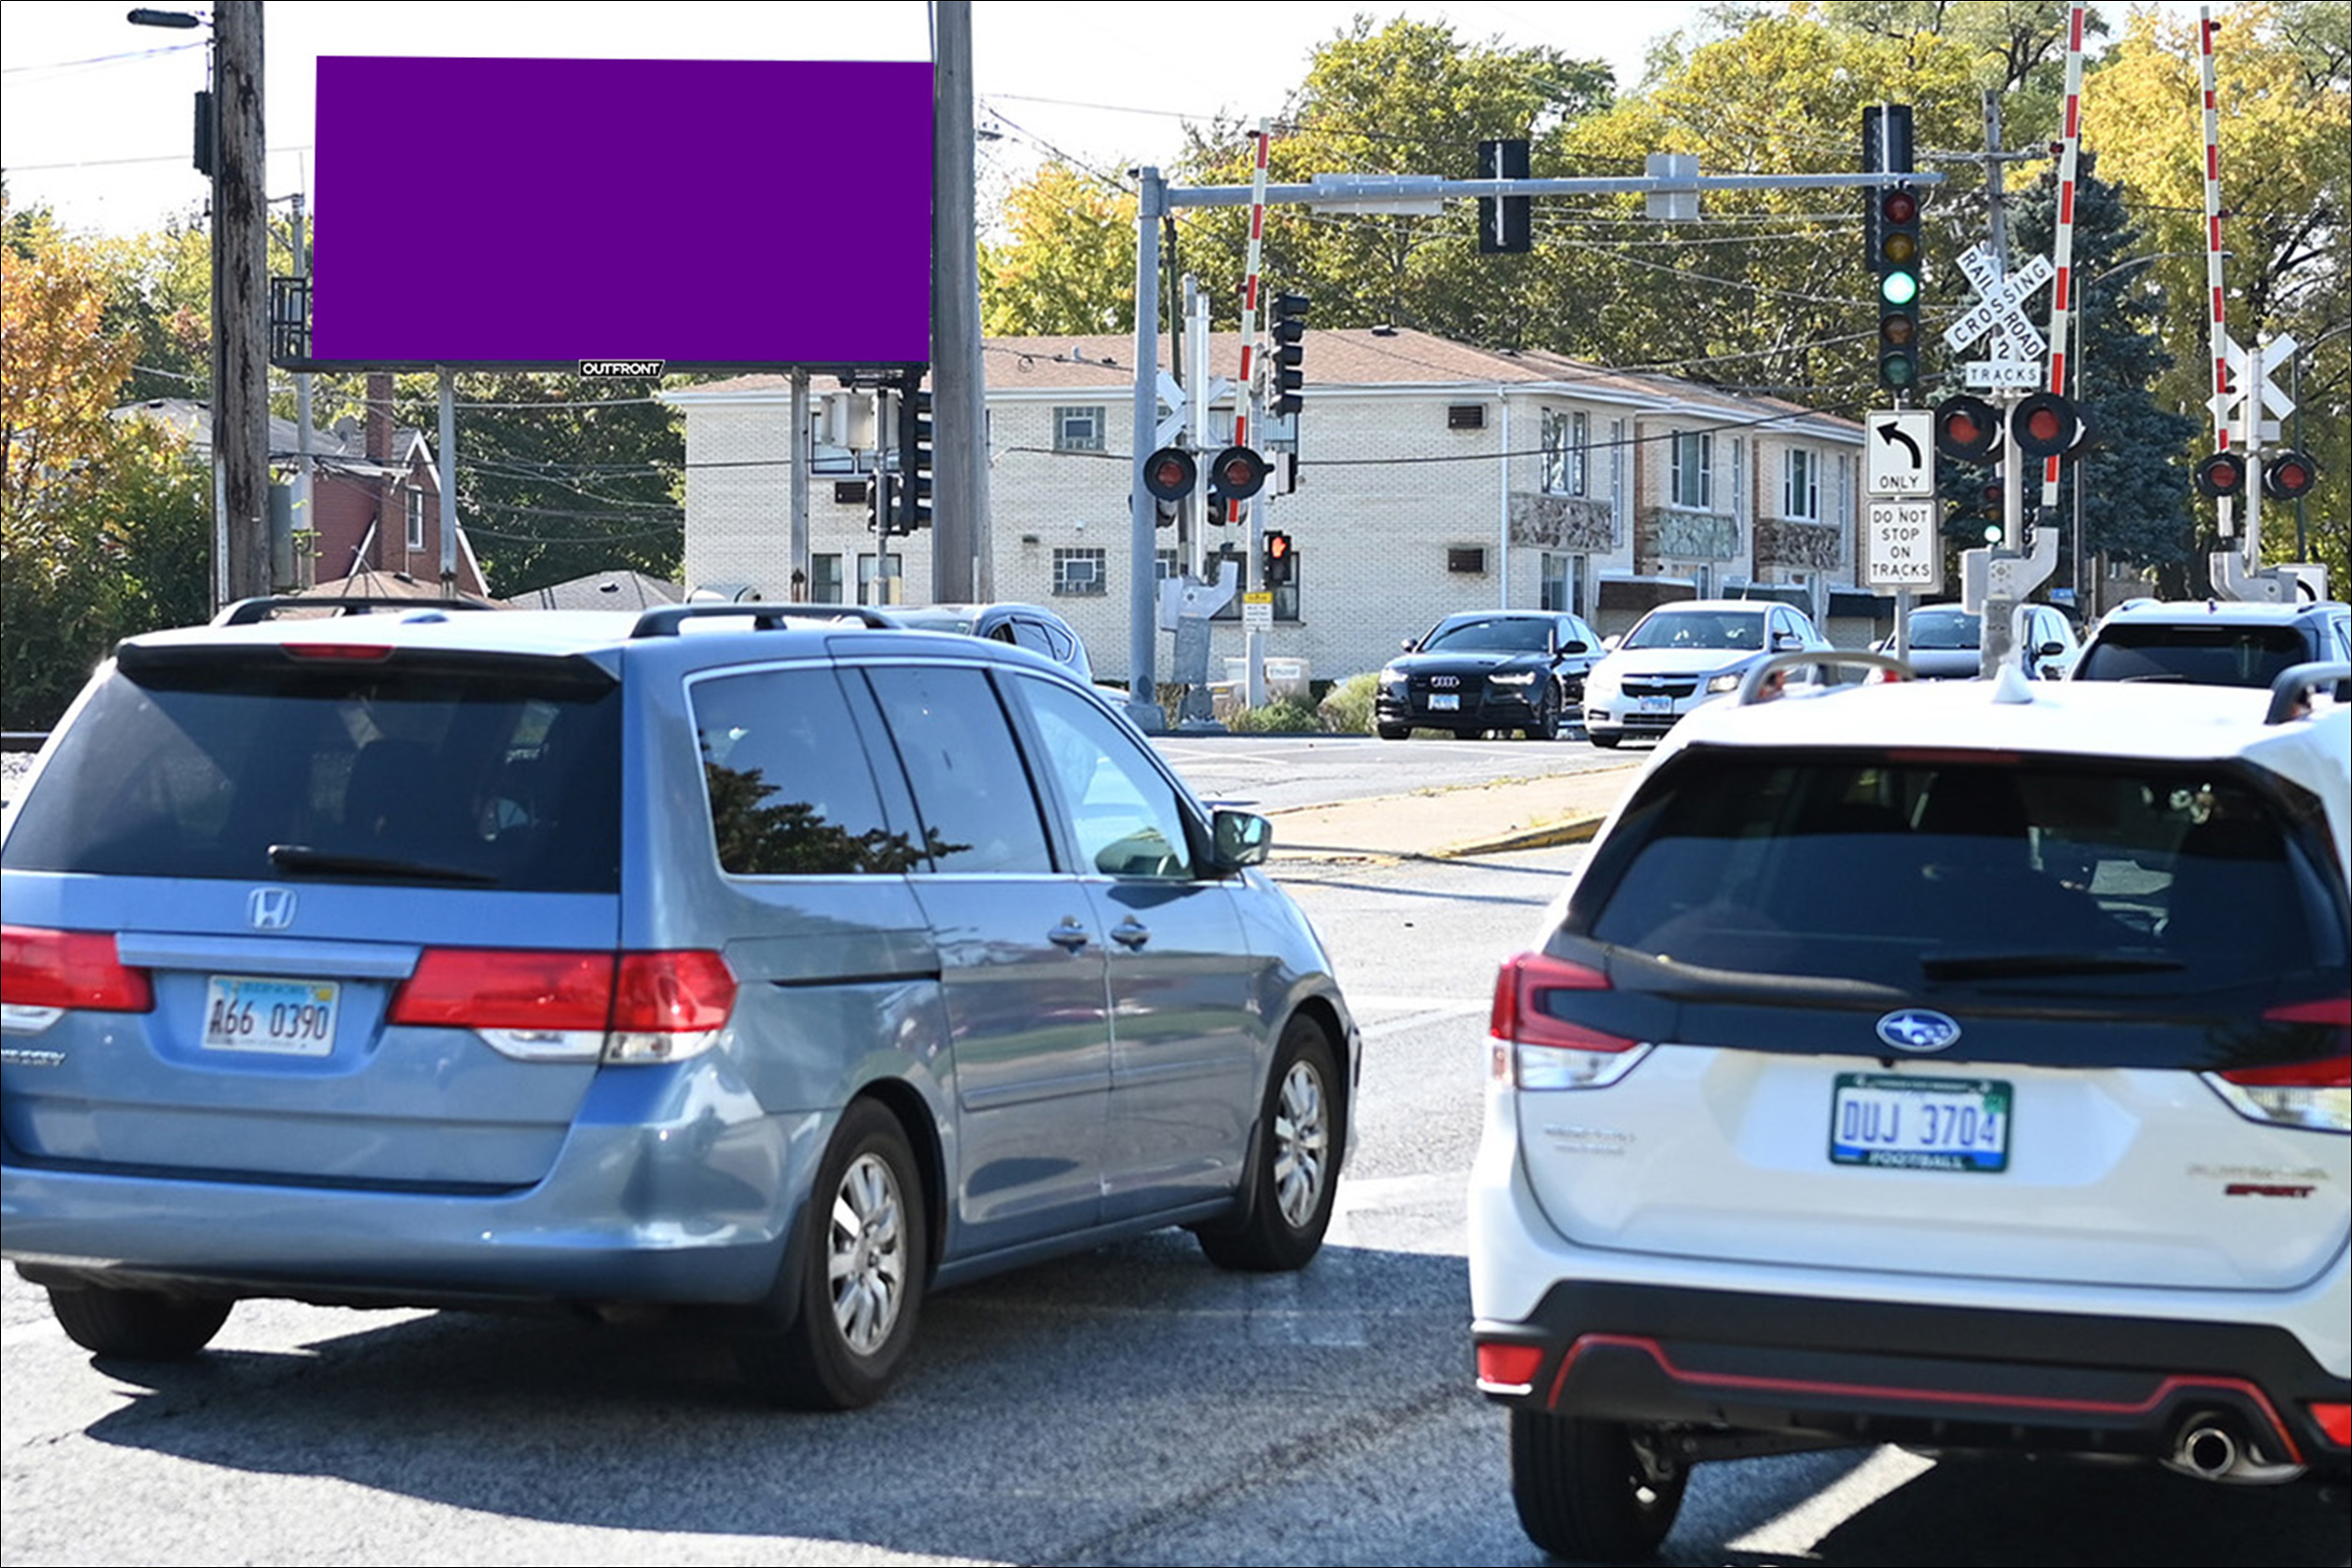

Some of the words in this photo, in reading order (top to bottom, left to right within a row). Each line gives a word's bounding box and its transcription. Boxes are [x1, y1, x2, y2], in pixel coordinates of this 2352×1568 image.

[1953, 263, 2047, 344] CROSSING
[1962, 252, 1994, 296] RAIL
[2003, 311, 2041, 357] ROAD
[1997, 341, 2010, 361] 2
[582, 362, 661, 375] OUTFRONT
[1971, 368, 2037, 382] TRACKS
[1879, 474, 1919, 490] ONLY
[1873, 510, 1893, 524] DO
[1898, 510, 1928, 524] NOT
[1881, 527, 1921, 542] STOP
[1889, 545, 1911, 560] ON
[1872, 563, 1931, 577] TRACKS
[209, 998, 255, 1036] A66
[269, 1002, 330, 1041] 0390
[1841, 1100, 1900, 1144] DUJ
[1919, 1102, 1997, 1148] 3704
